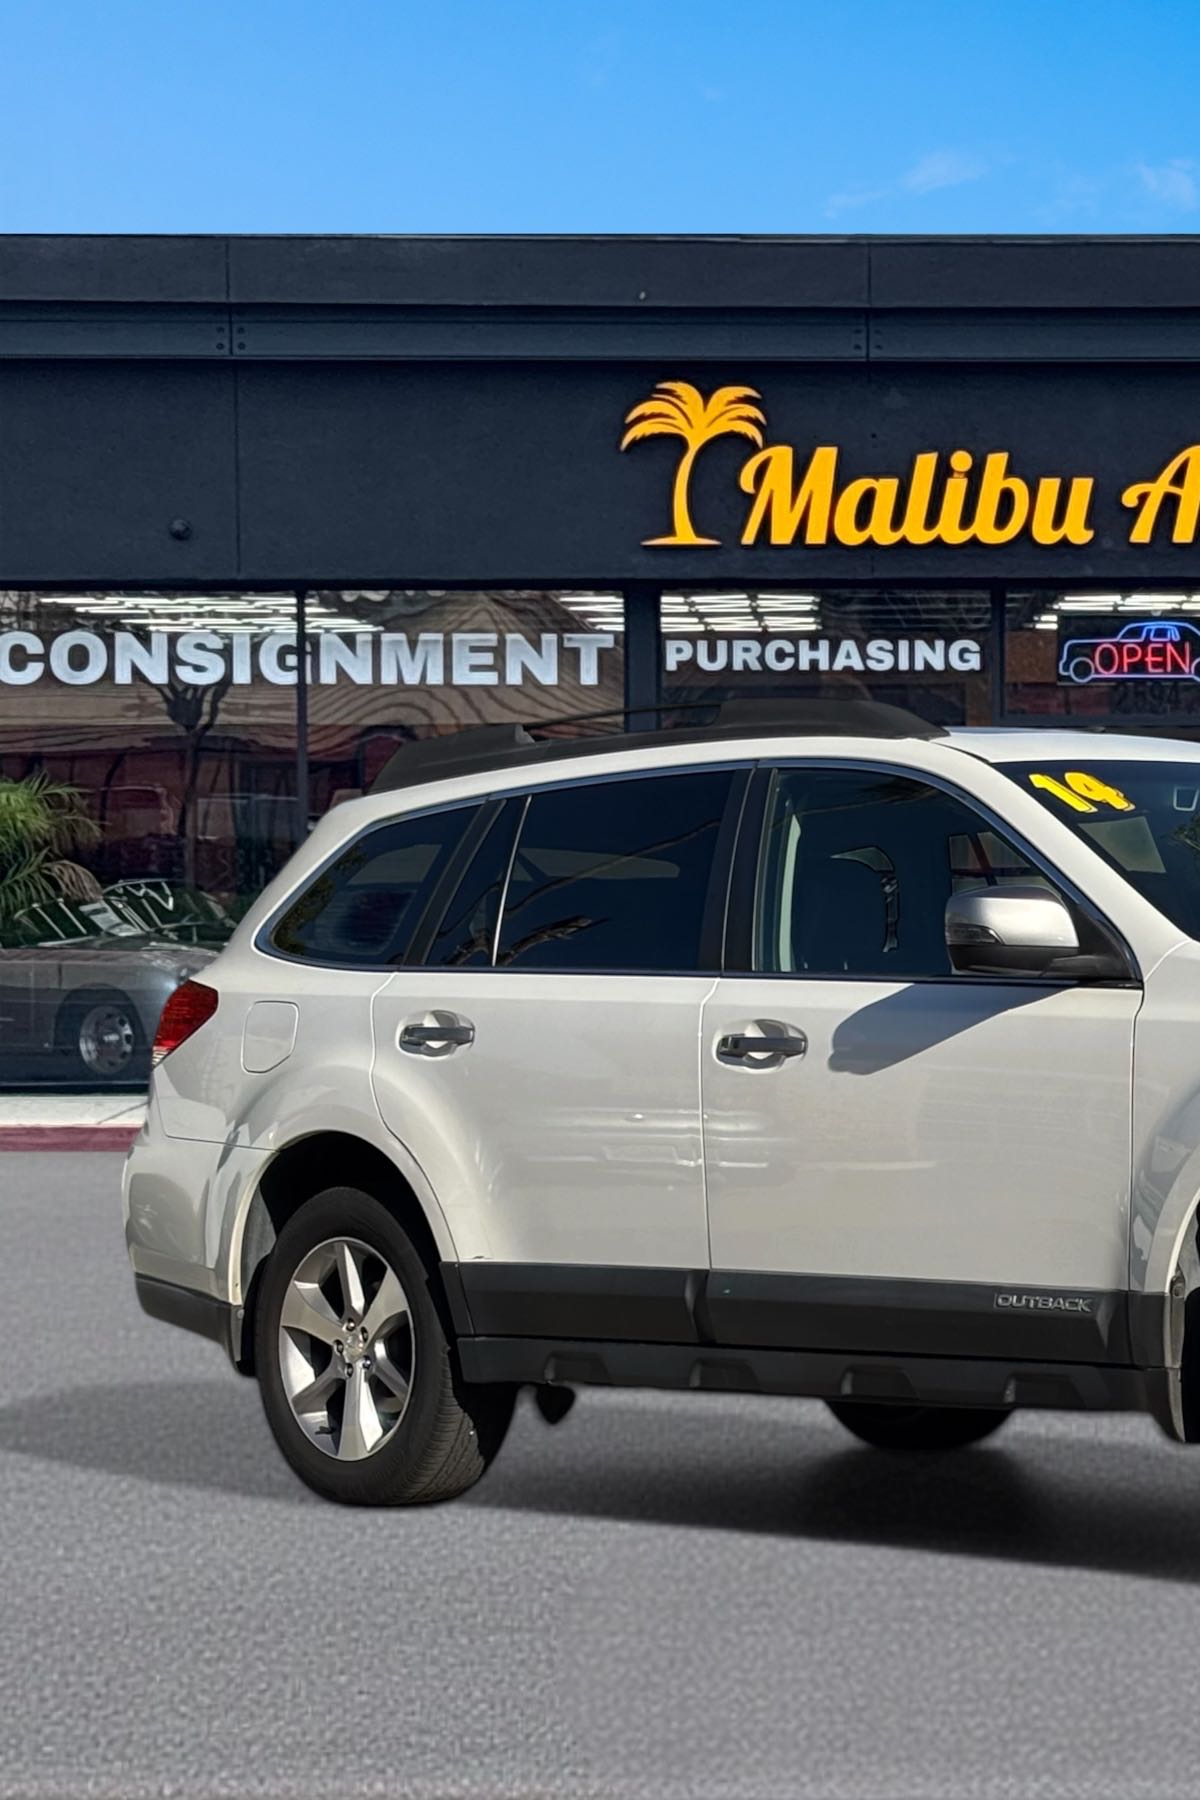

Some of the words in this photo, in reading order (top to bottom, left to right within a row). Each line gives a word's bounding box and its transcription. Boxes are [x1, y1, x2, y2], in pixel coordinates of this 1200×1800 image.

[740, 446, 1093, 546] Malibu
[0, 630, 615, 686] CONSIGNMENT
[665, 639, 981, 672] PURCHASING
[1094, 641, 1192, 675] OPEN
[1029, 771, 1136, 813] 14
[996, 1293, 1092, 1313] OUTBACK
